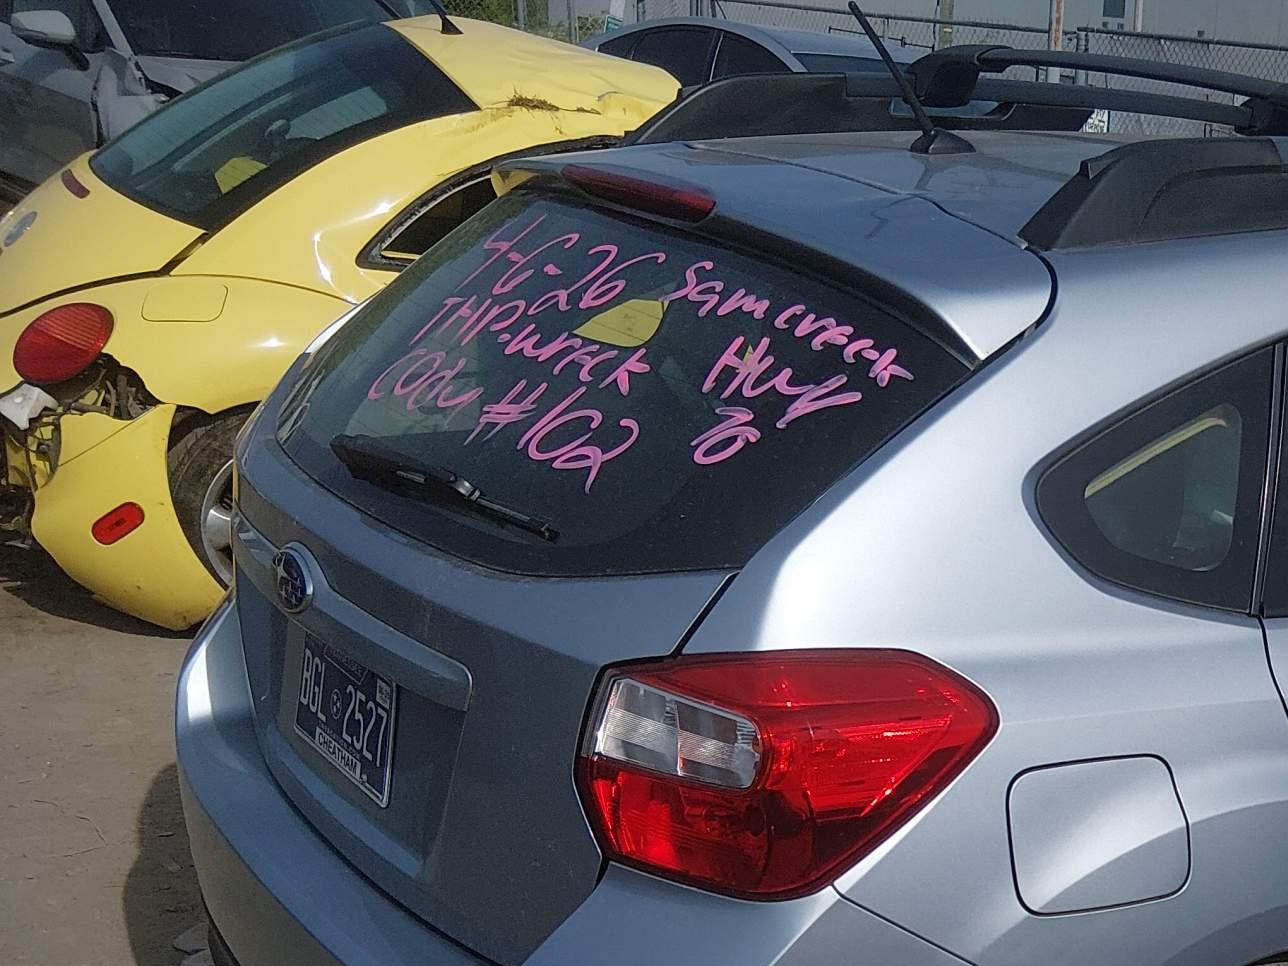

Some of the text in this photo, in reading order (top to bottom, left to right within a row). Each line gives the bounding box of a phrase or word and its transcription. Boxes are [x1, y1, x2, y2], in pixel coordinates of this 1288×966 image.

[300, 648, 326, 723] BGL
[342, 685, 388, 768] 2527
[319, 733, 358, 778] CHEATHAM
